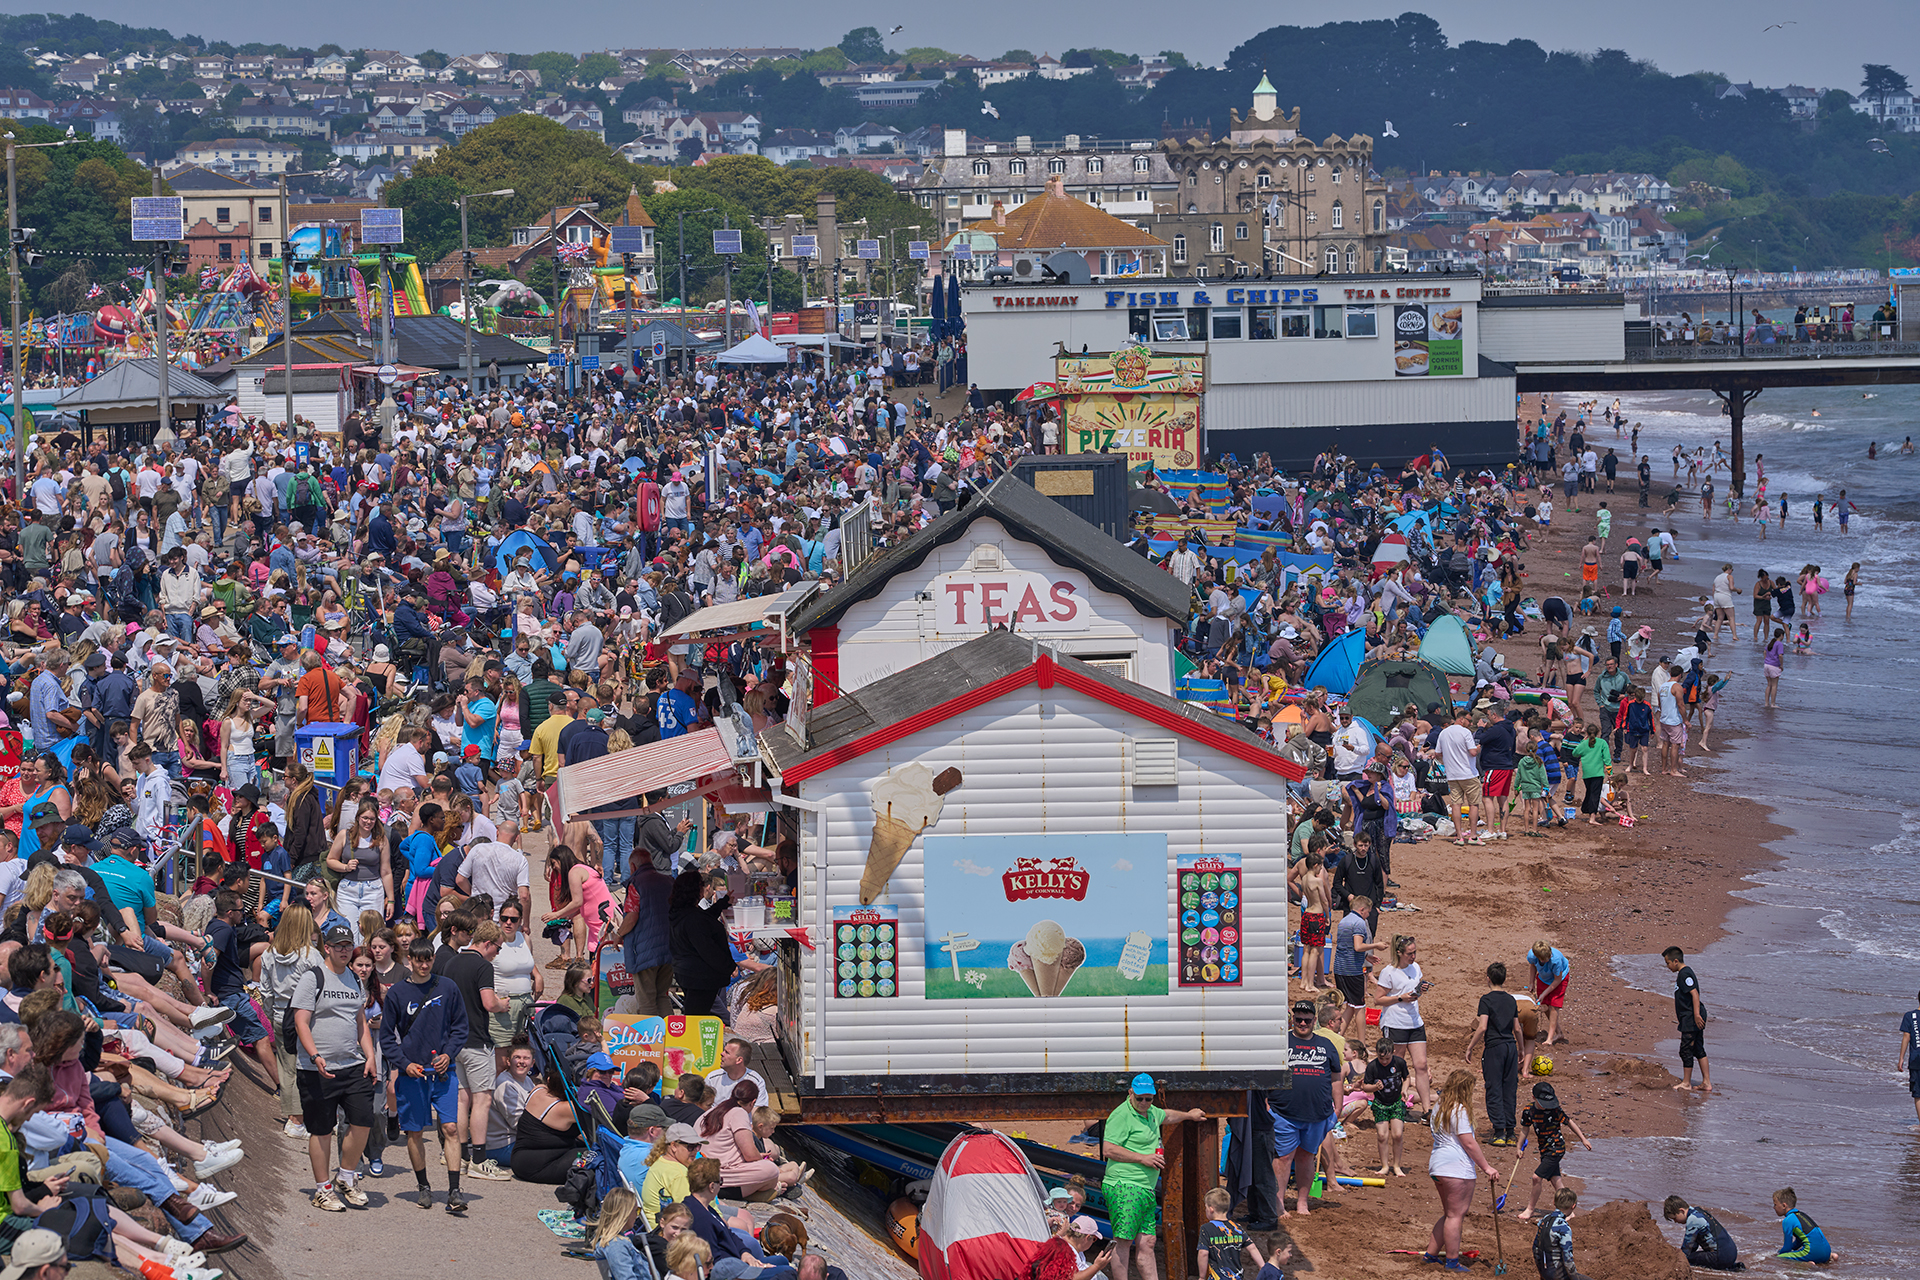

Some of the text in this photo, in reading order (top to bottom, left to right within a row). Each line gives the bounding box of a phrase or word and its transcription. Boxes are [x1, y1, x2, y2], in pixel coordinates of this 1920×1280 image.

[1105, 288, 1319, 307] FISH & CHIPS
[1344, 287, 1451, 299] TEA & COFFEE
[993, 296, 1079, 307] TAKEAWAY
[1080, 428, 1185, 452] PIZZERIA
[298, 446, 306, 454] P
[1127, 452, 1153, 461] COME
[945, 580, 1077, 625] TEAS
[1010, 873, 1082, 891] KELLY'S
[336, 927, 349, 936] NY
[611, 972, 633, 981] KEL
[323, 990, 360, 1000] FIRETRAP
[606, 1024, 663, 1048] Slush
